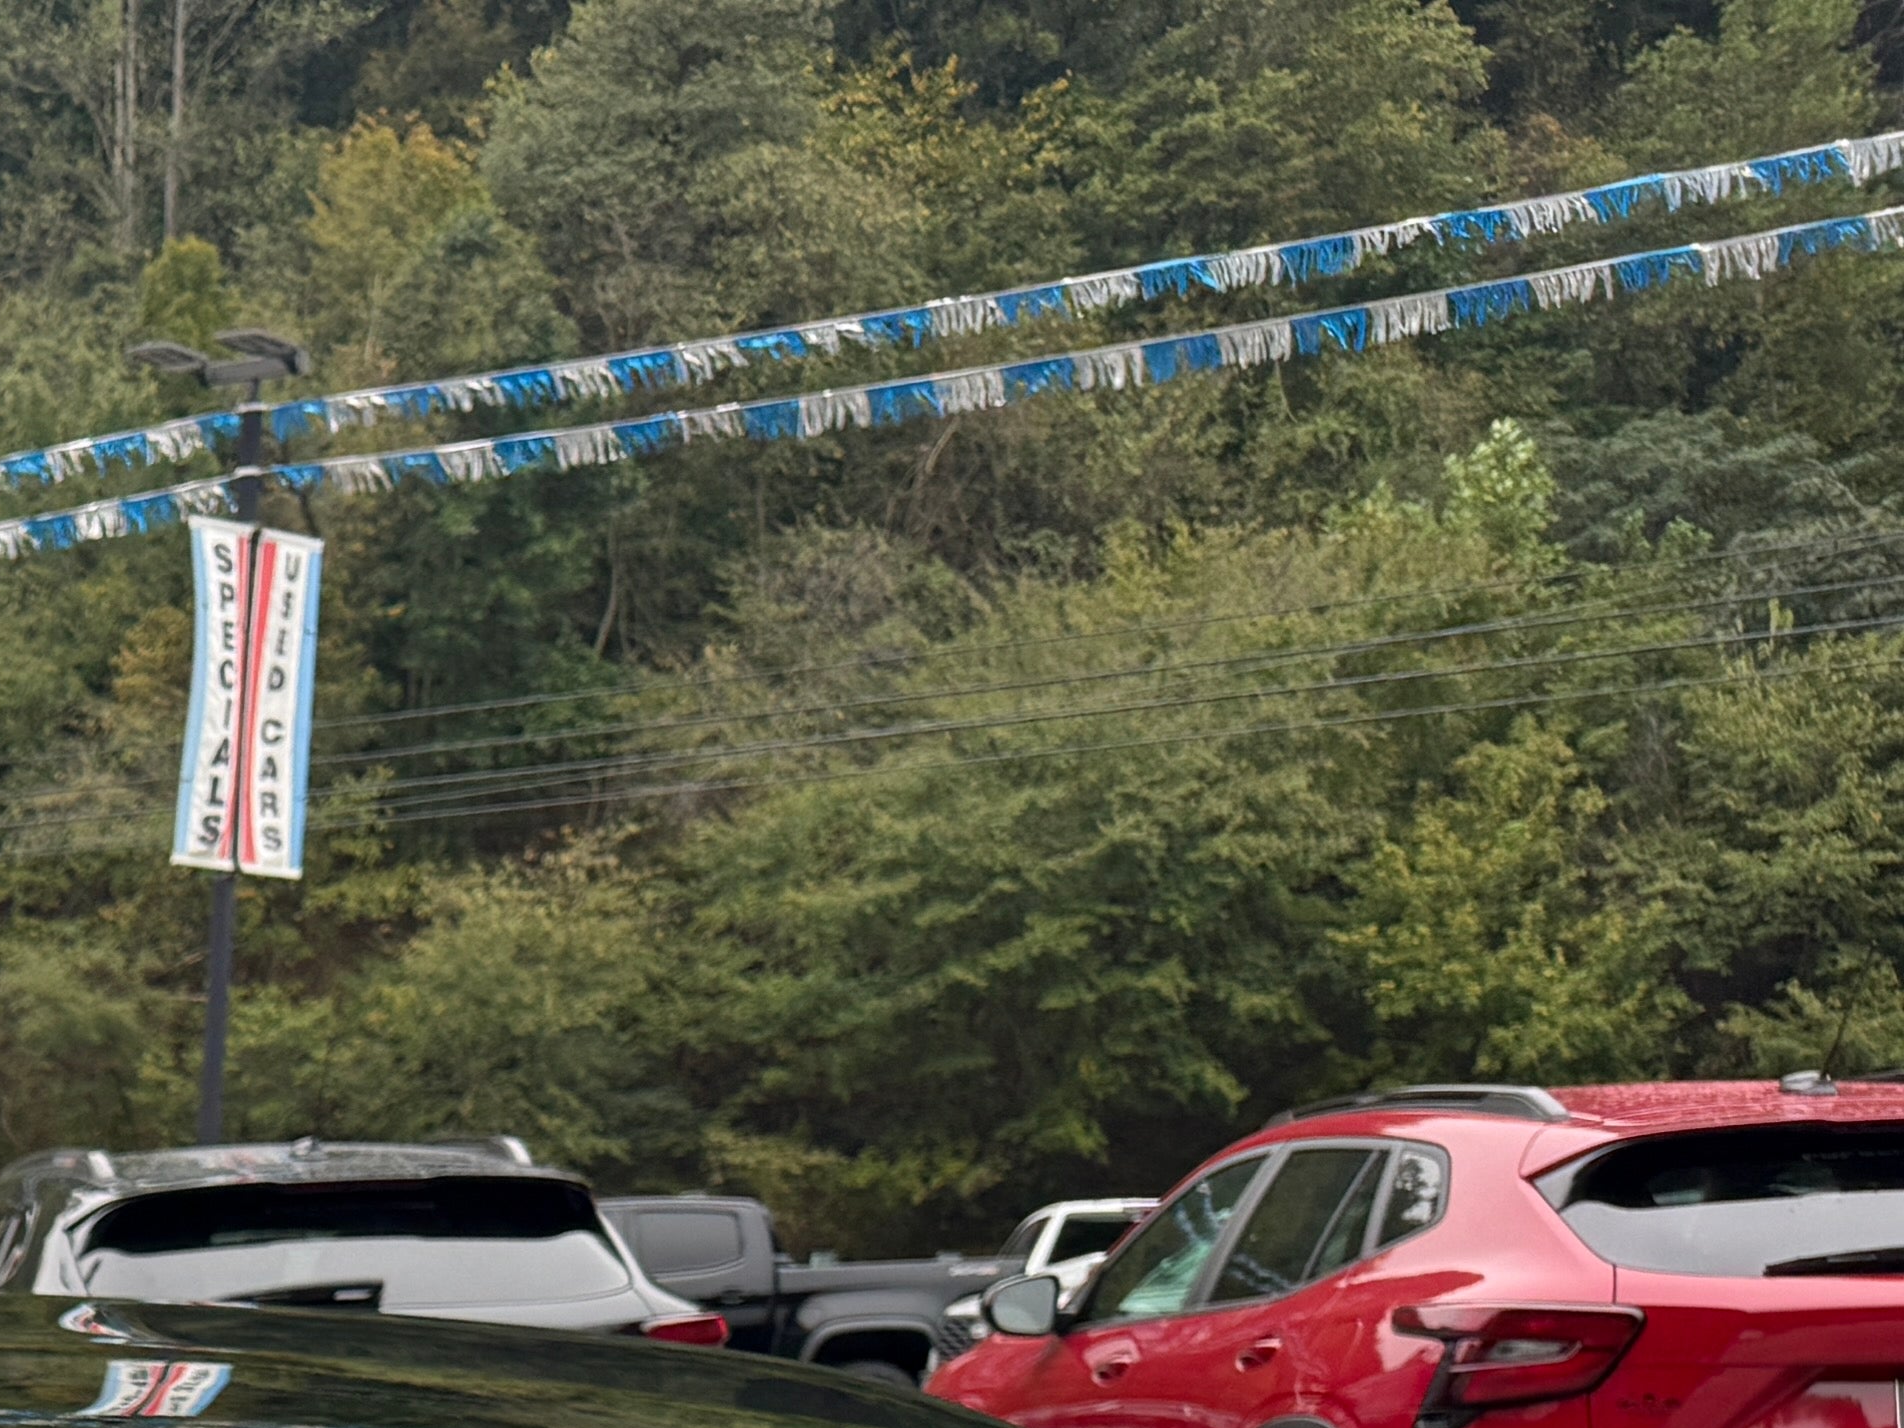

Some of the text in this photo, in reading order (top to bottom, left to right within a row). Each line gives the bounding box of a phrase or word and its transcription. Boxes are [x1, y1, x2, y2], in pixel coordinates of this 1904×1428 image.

[198, 542, 236, 847] SPECIALS
[259, 552, 301, 853] USED CARS
